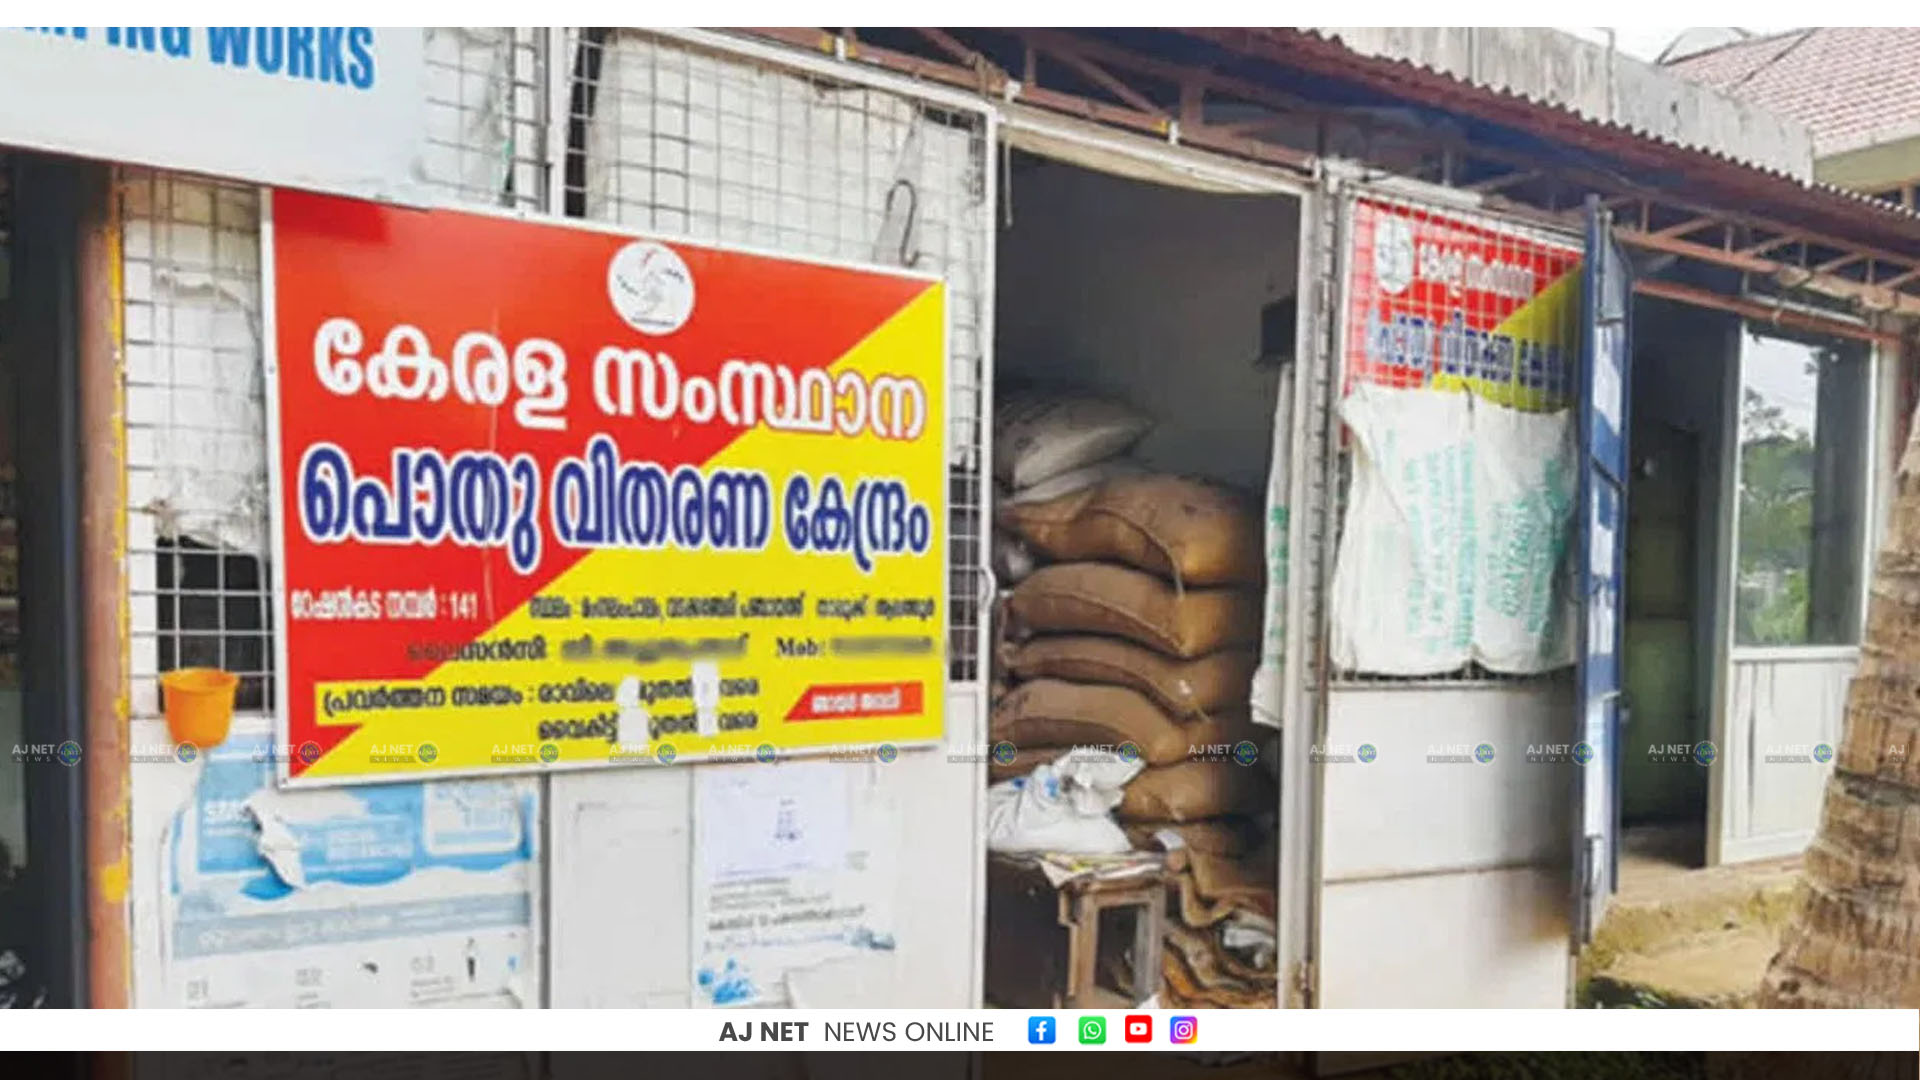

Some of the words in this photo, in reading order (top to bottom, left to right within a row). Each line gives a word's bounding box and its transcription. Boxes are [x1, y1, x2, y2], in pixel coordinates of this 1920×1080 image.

[207, 27, 375, 90] WORKS
[314, 317, 568, 430] കേരള
[592, 344, 926, 441] സംസ്ഥാന
[301, 443, 540, 573] പൊതു
[551, 434, 771, 550] വിതരണ
[783, 473, 932, 573] കേന്ദ്രം
[452, 592, 477, 619] 141
